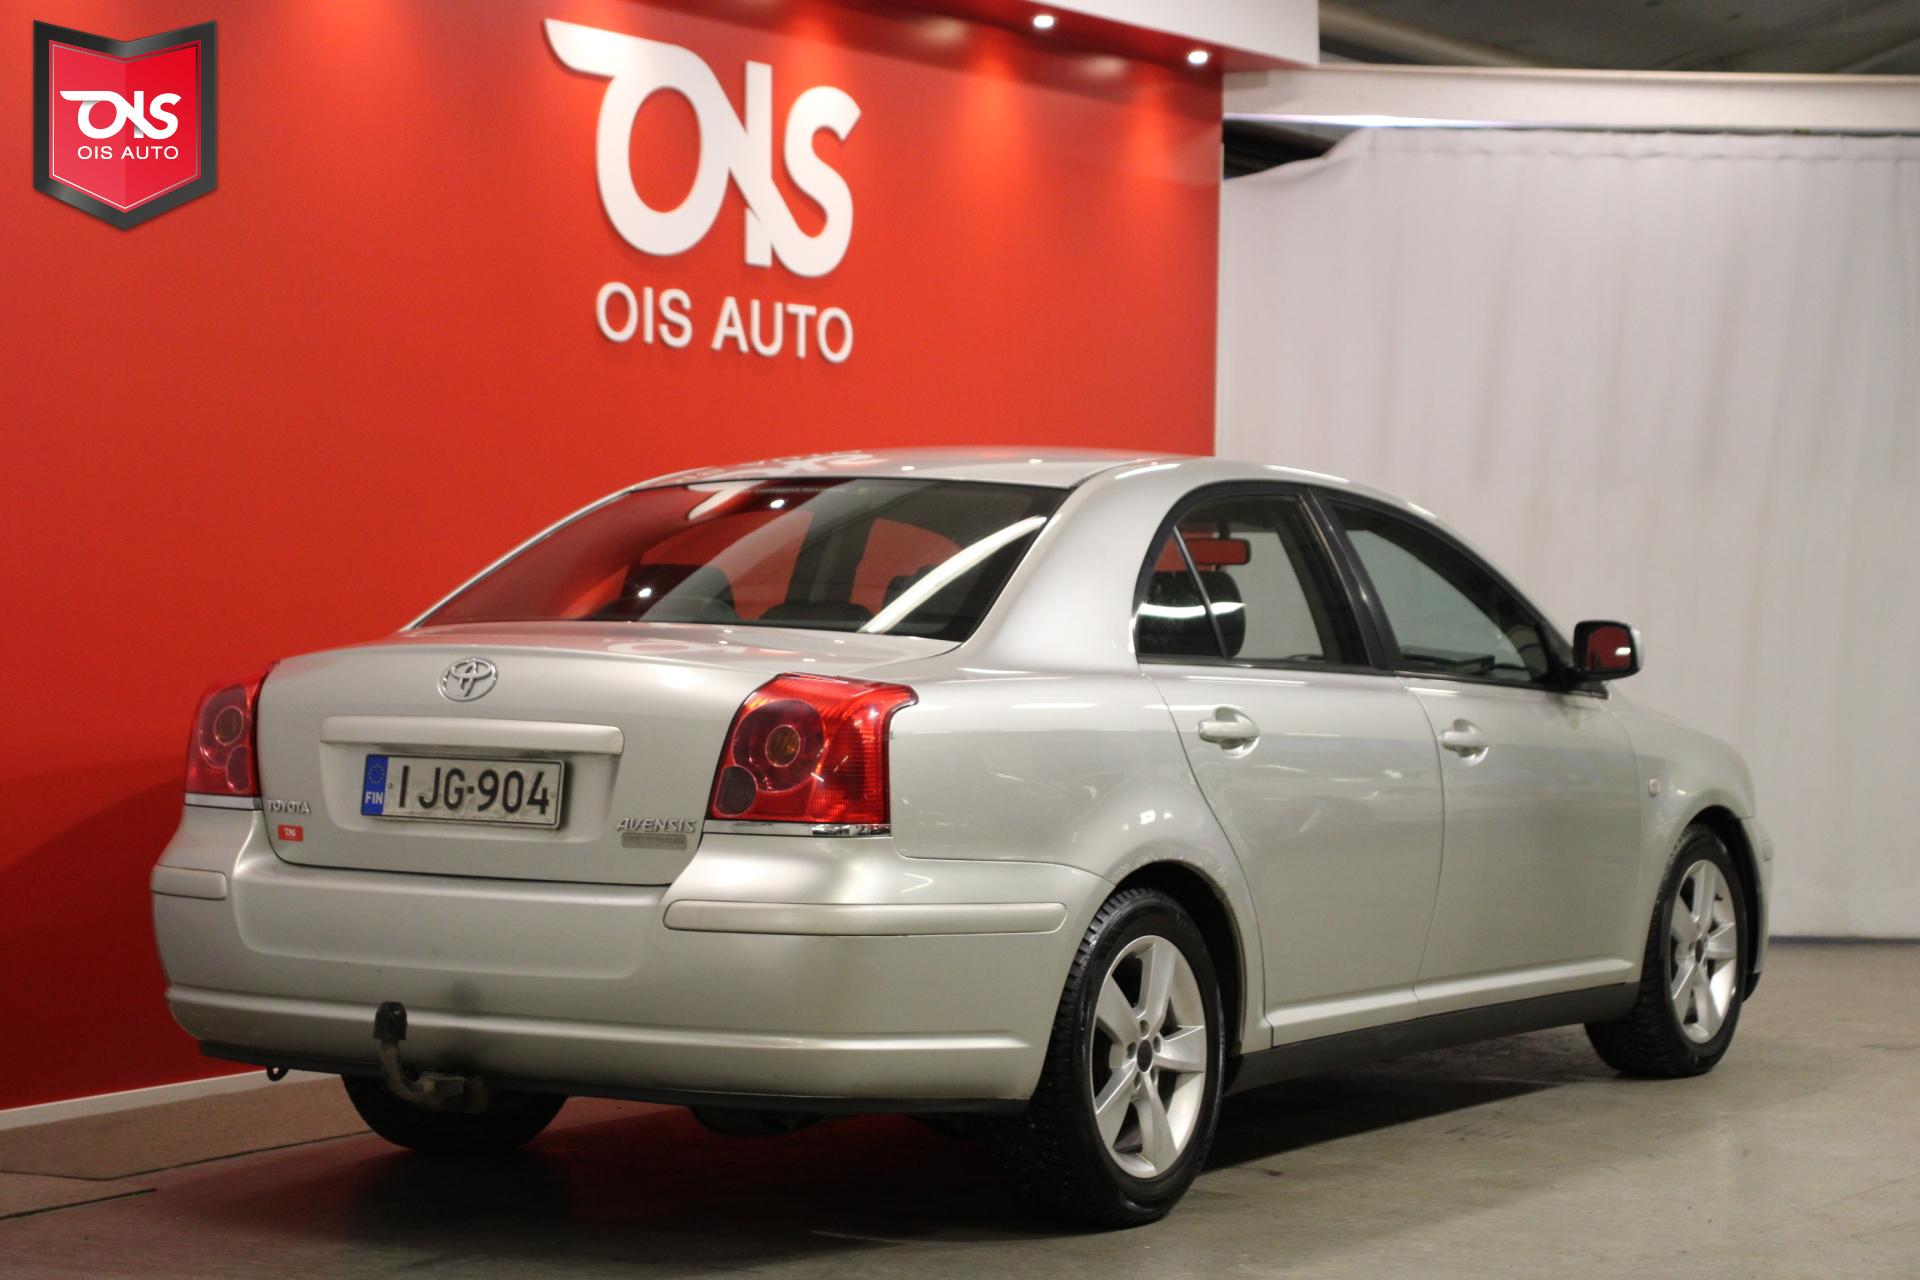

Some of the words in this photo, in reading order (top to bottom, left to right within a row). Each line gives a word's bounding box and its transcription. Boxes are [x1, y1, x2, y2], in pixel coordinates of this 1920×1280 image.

[544, 18, 862, 278] OIS
[596, 281, 693, 348] OIS
[711, 296, 854, 364] AUTO
[266, 799, 312, 815] TOYOTA
[364, 790, 384, 805] FIN
[398, 765, 550, 816] IJG-904
[616, 817, 697, 833] AVENSIS
